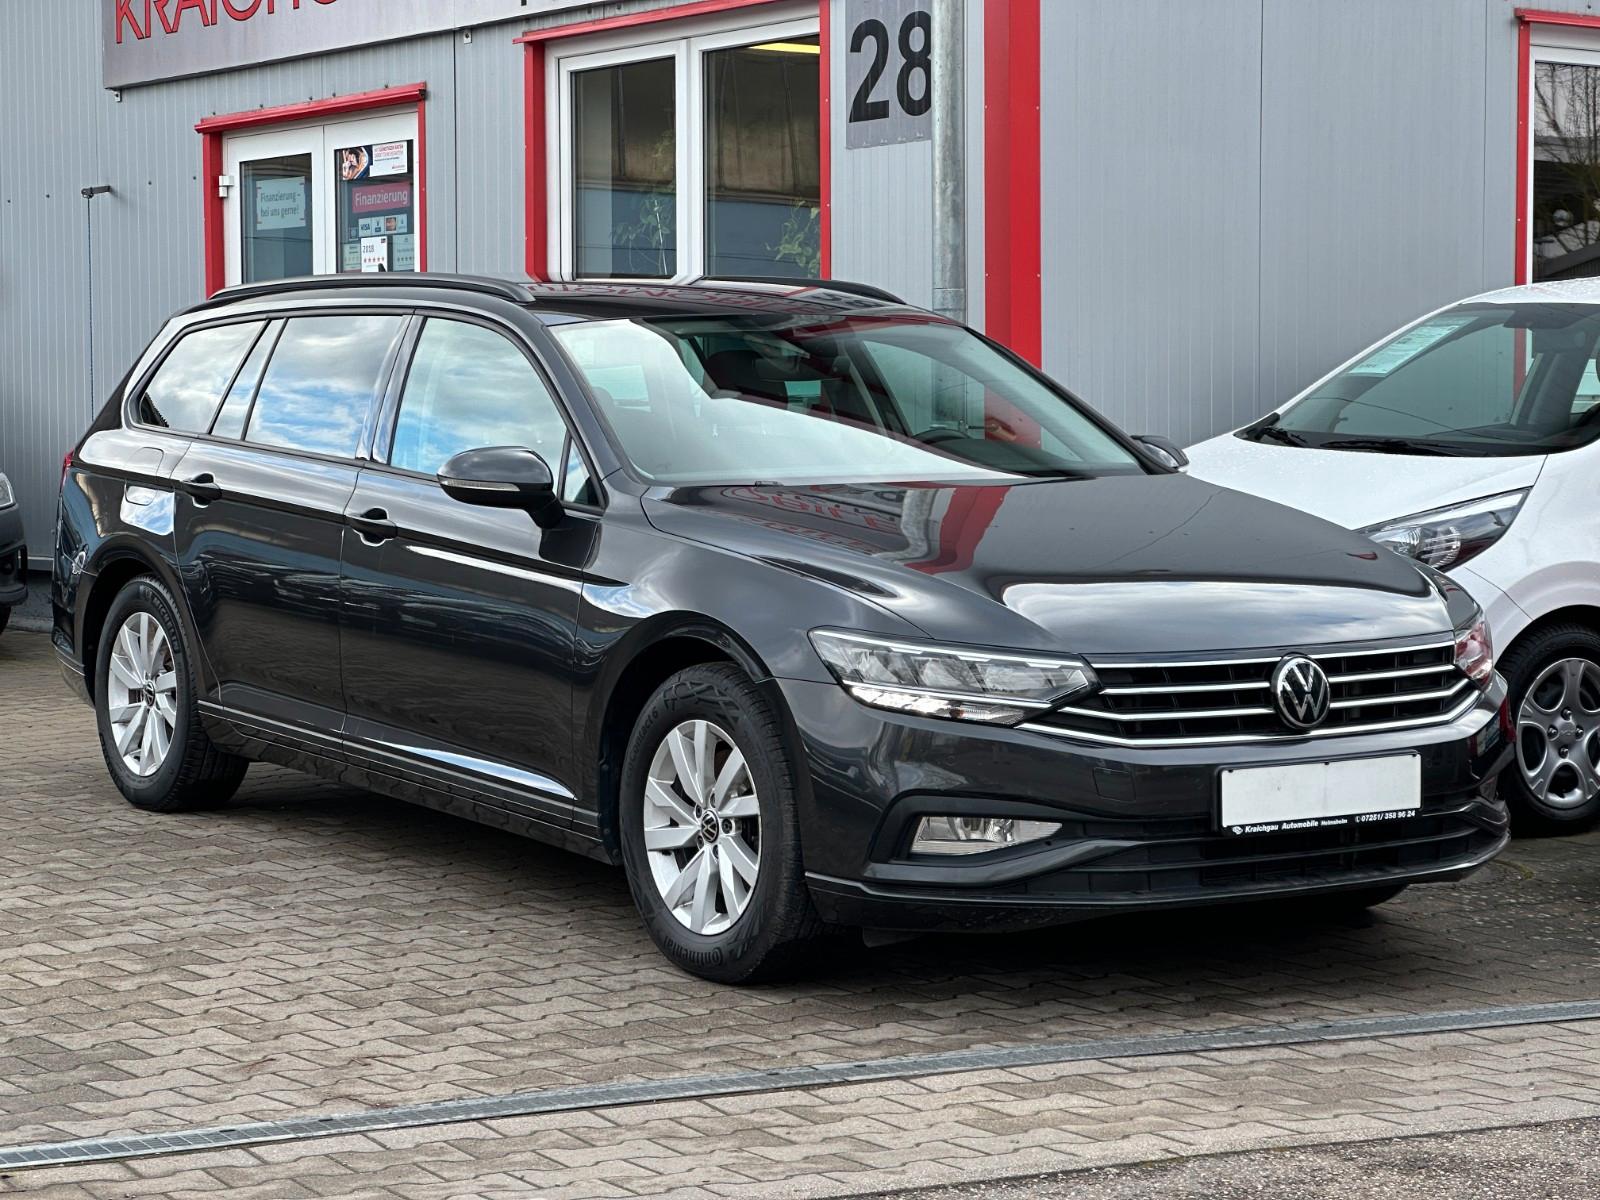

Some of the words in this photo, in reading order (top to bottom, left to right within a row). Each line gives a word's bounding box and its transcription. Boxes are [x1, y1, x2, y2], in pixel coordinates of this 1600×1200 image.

[849, 10, 931, 123] 28
[355, 190, 408, 207] Finanzierung
[360, 223, 370, 231] VISA
[1244, 824, 1279, 833] Kraichgau
[1281, 819, 1319, 830] Automobile
[1384, 811, 1397, 820] 358
[1407, 809, 1416, 818] 24
